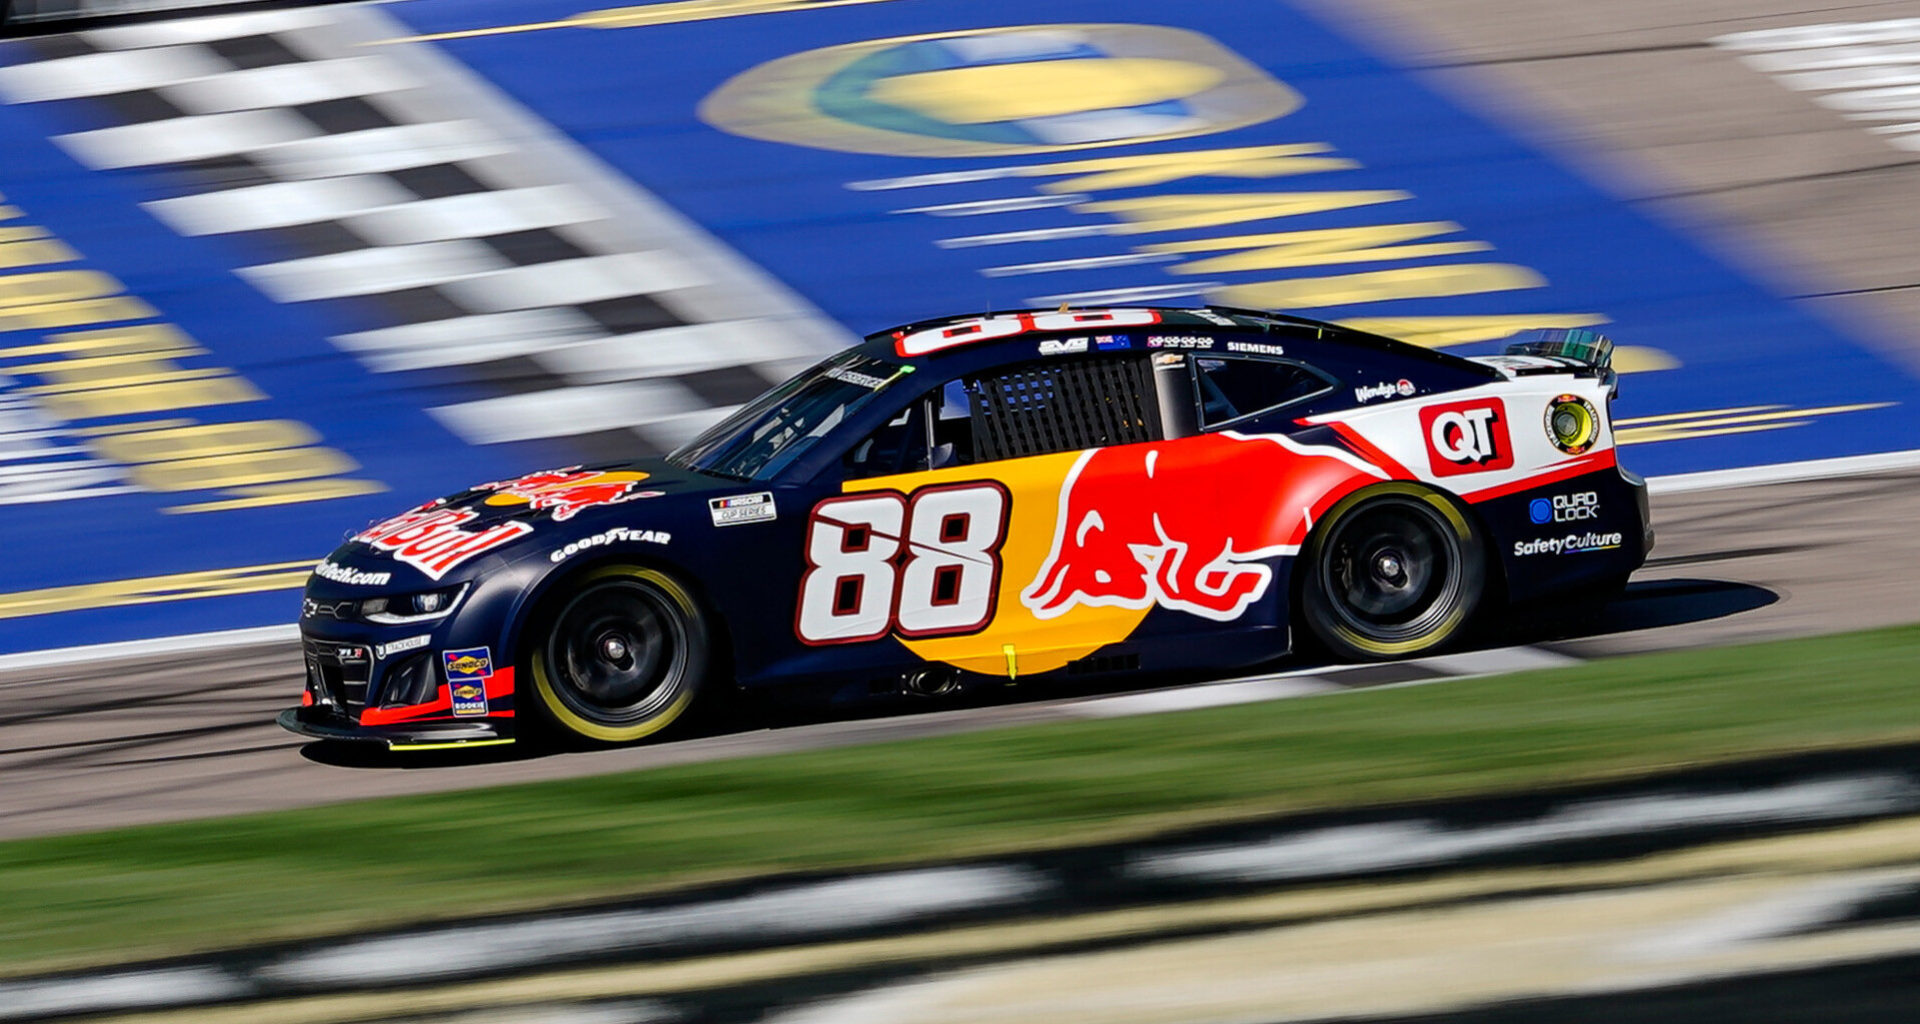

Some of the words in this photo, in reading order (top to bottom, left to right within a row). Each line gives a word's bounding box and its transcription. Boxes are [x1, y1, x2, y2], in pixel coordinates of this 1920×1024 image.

[1227, 341, 1284, 356] SIEMENS
[1355, 381, 1396, 403] Wendy's
[1430, 407, 1498, 465] QT
[1553, 491, 1597, 509] QUAD
[1554, 505, 1600, 522] LOCK
[369, 506, 534, 581] Bull
[550, 527, 671, 563] GOODYEAR
[1514, 532, 1622, 556] SafetyCulture
[794, 480, 1012, 646] 88
[447, 658, 489, 671] SUNOCO
[455, 702, 485, 710] ROOKIE
